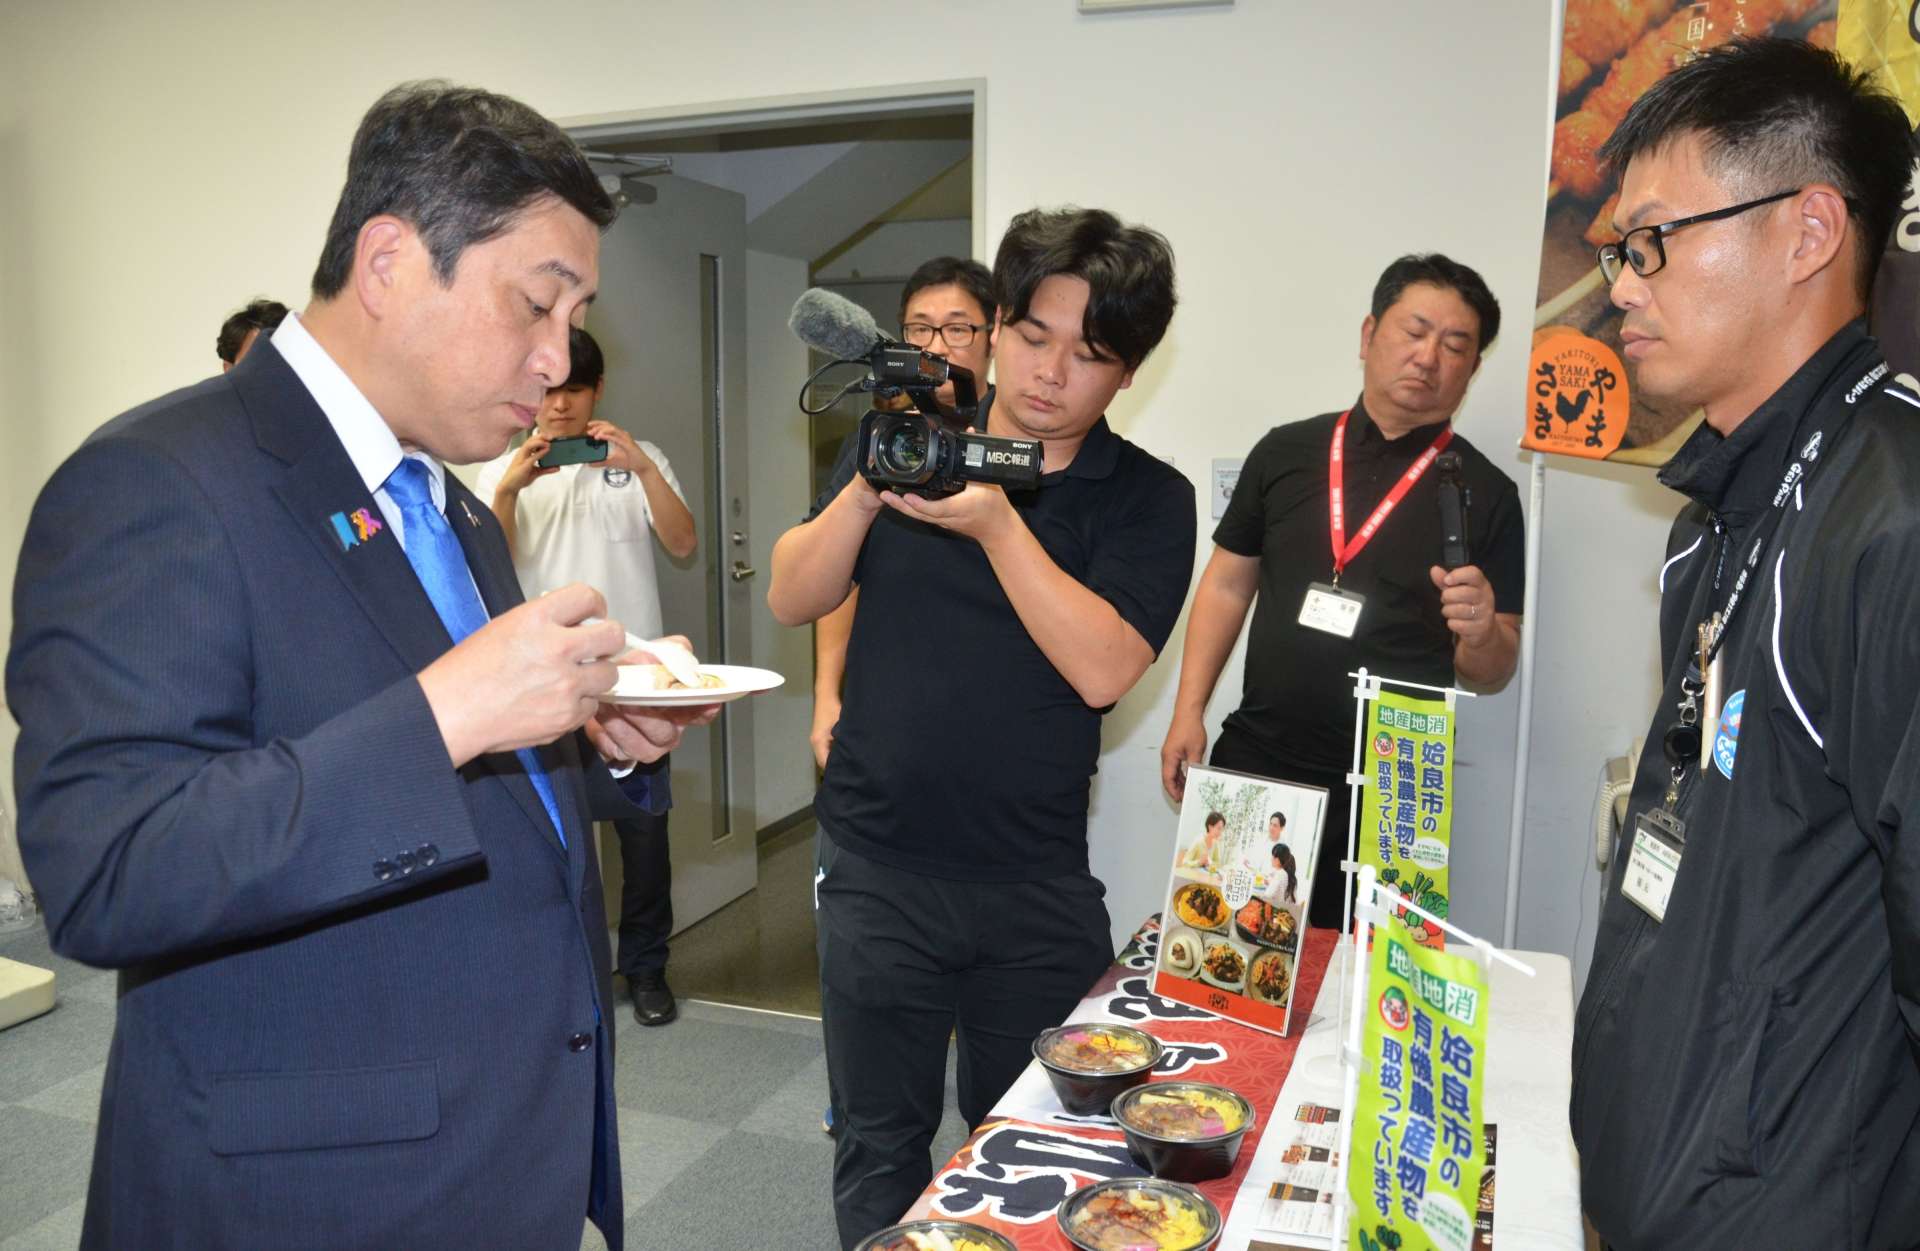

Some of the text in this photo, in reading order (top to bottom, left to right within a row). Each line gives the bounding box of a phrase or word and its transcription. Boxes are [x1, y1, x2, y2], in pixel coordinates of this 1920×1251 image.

[1554, 348, 1601, 369] YAKITORI
[1558, 364, 1591, 377] YAMA
[1558, 376, 1587, 389] SAKI
[1012, 442, 1033, 450] SONY
[1379, 705, 1447, 735] 地産地消
[1394, 736, 1417, 860] 有機農産物を
[1377, 760, 1395, 868] 取扱っています。
